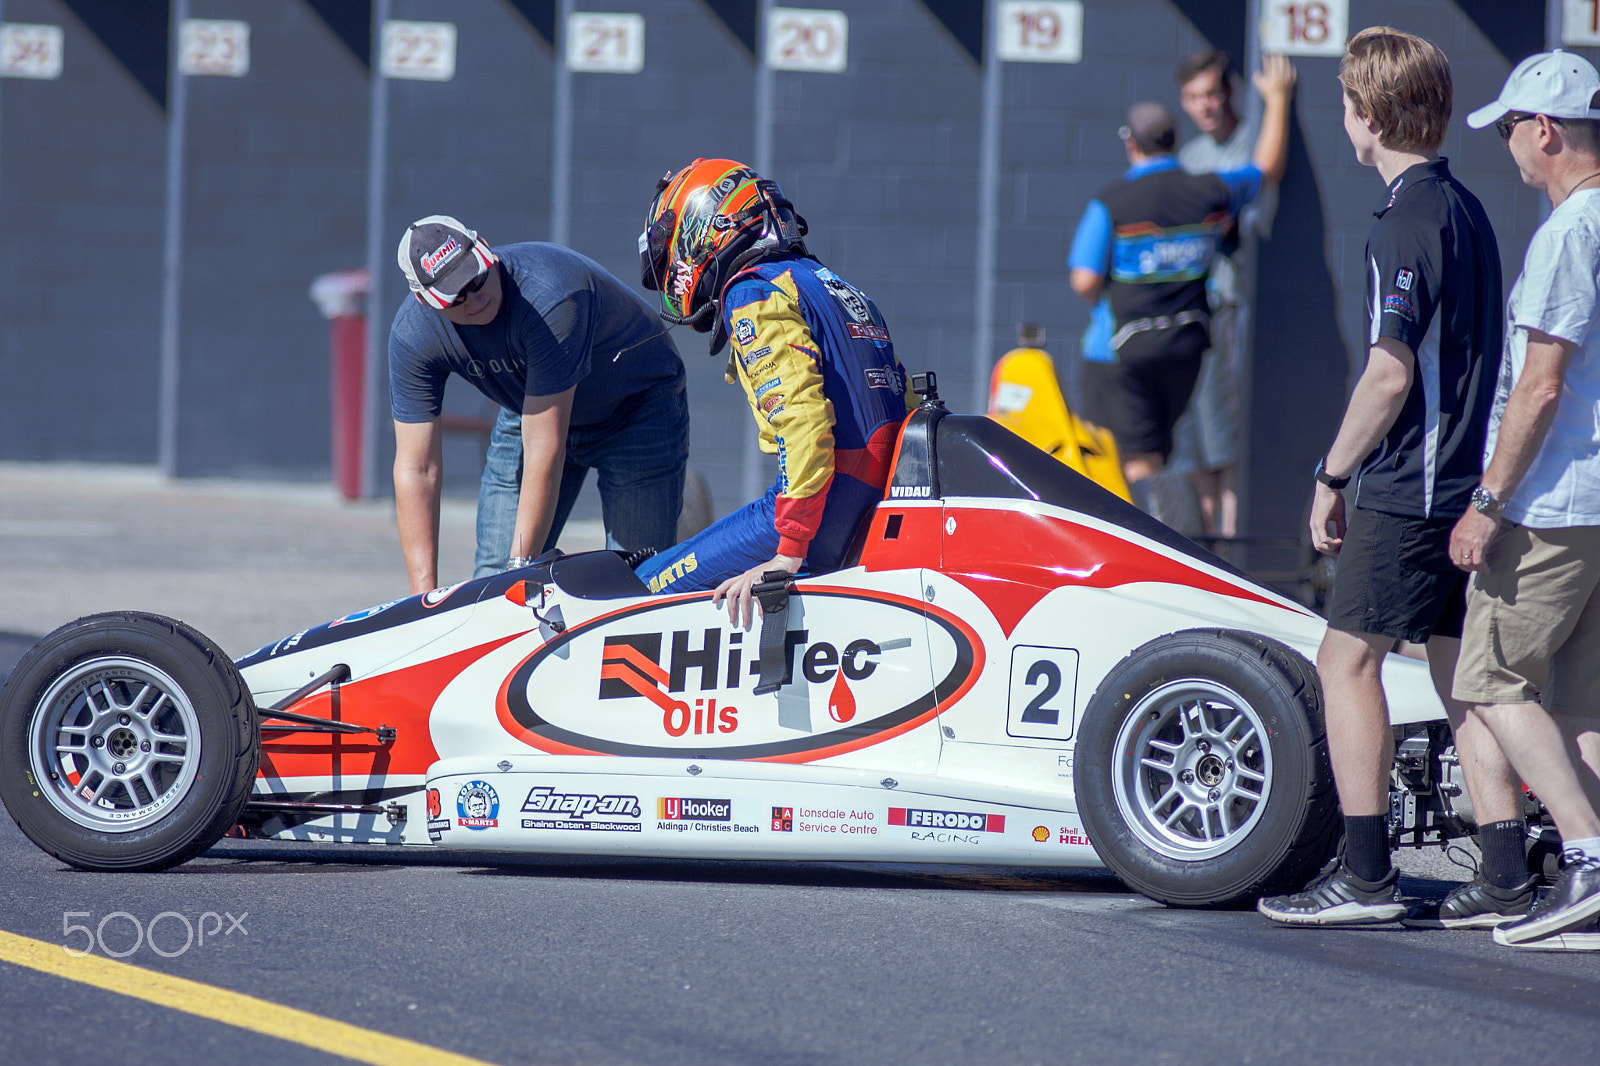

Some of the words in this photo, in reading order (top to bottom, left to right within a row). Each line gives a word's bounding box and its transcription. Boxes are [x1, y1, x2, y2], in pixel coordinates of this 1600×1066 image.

[1014, 9, 1061, 49] 19
[1278, 2, 1329, 45] 18
[393, 29, 441, 67] 22
[583, 23, 629, 60] 21
[779, 19, 836, 60] 20
[890, 486, 931, 498] VIDAU
[646, 551, 698, 594] ARTS
[1021, 660, 1060, 726] 2
[663, 698, 739, 738] Oils
[457, 782, 475, 804] BOB
[476, 782, 499, 805] JANE
[681, 799, 729, 817] Hooker
[799, 807, 846, 819] Lonsdale
[849, 810, 875, 820] Auto
[590, 822, 641, 832] Blackwood
[657, 822, 688, 832] Aldinga
[695, 823, 732, 832] Christies
[733, 824, 759, 832] Beach
[799, 821, 837, 833] Service
[840, 823, 878, 835] Centre
[910, 810, 984, 829] FERODO
[910, 831, 980, 845] RACING
[1059, 826, 1079, 835] Shell
[1059, 834, 1093, 846] HELI
